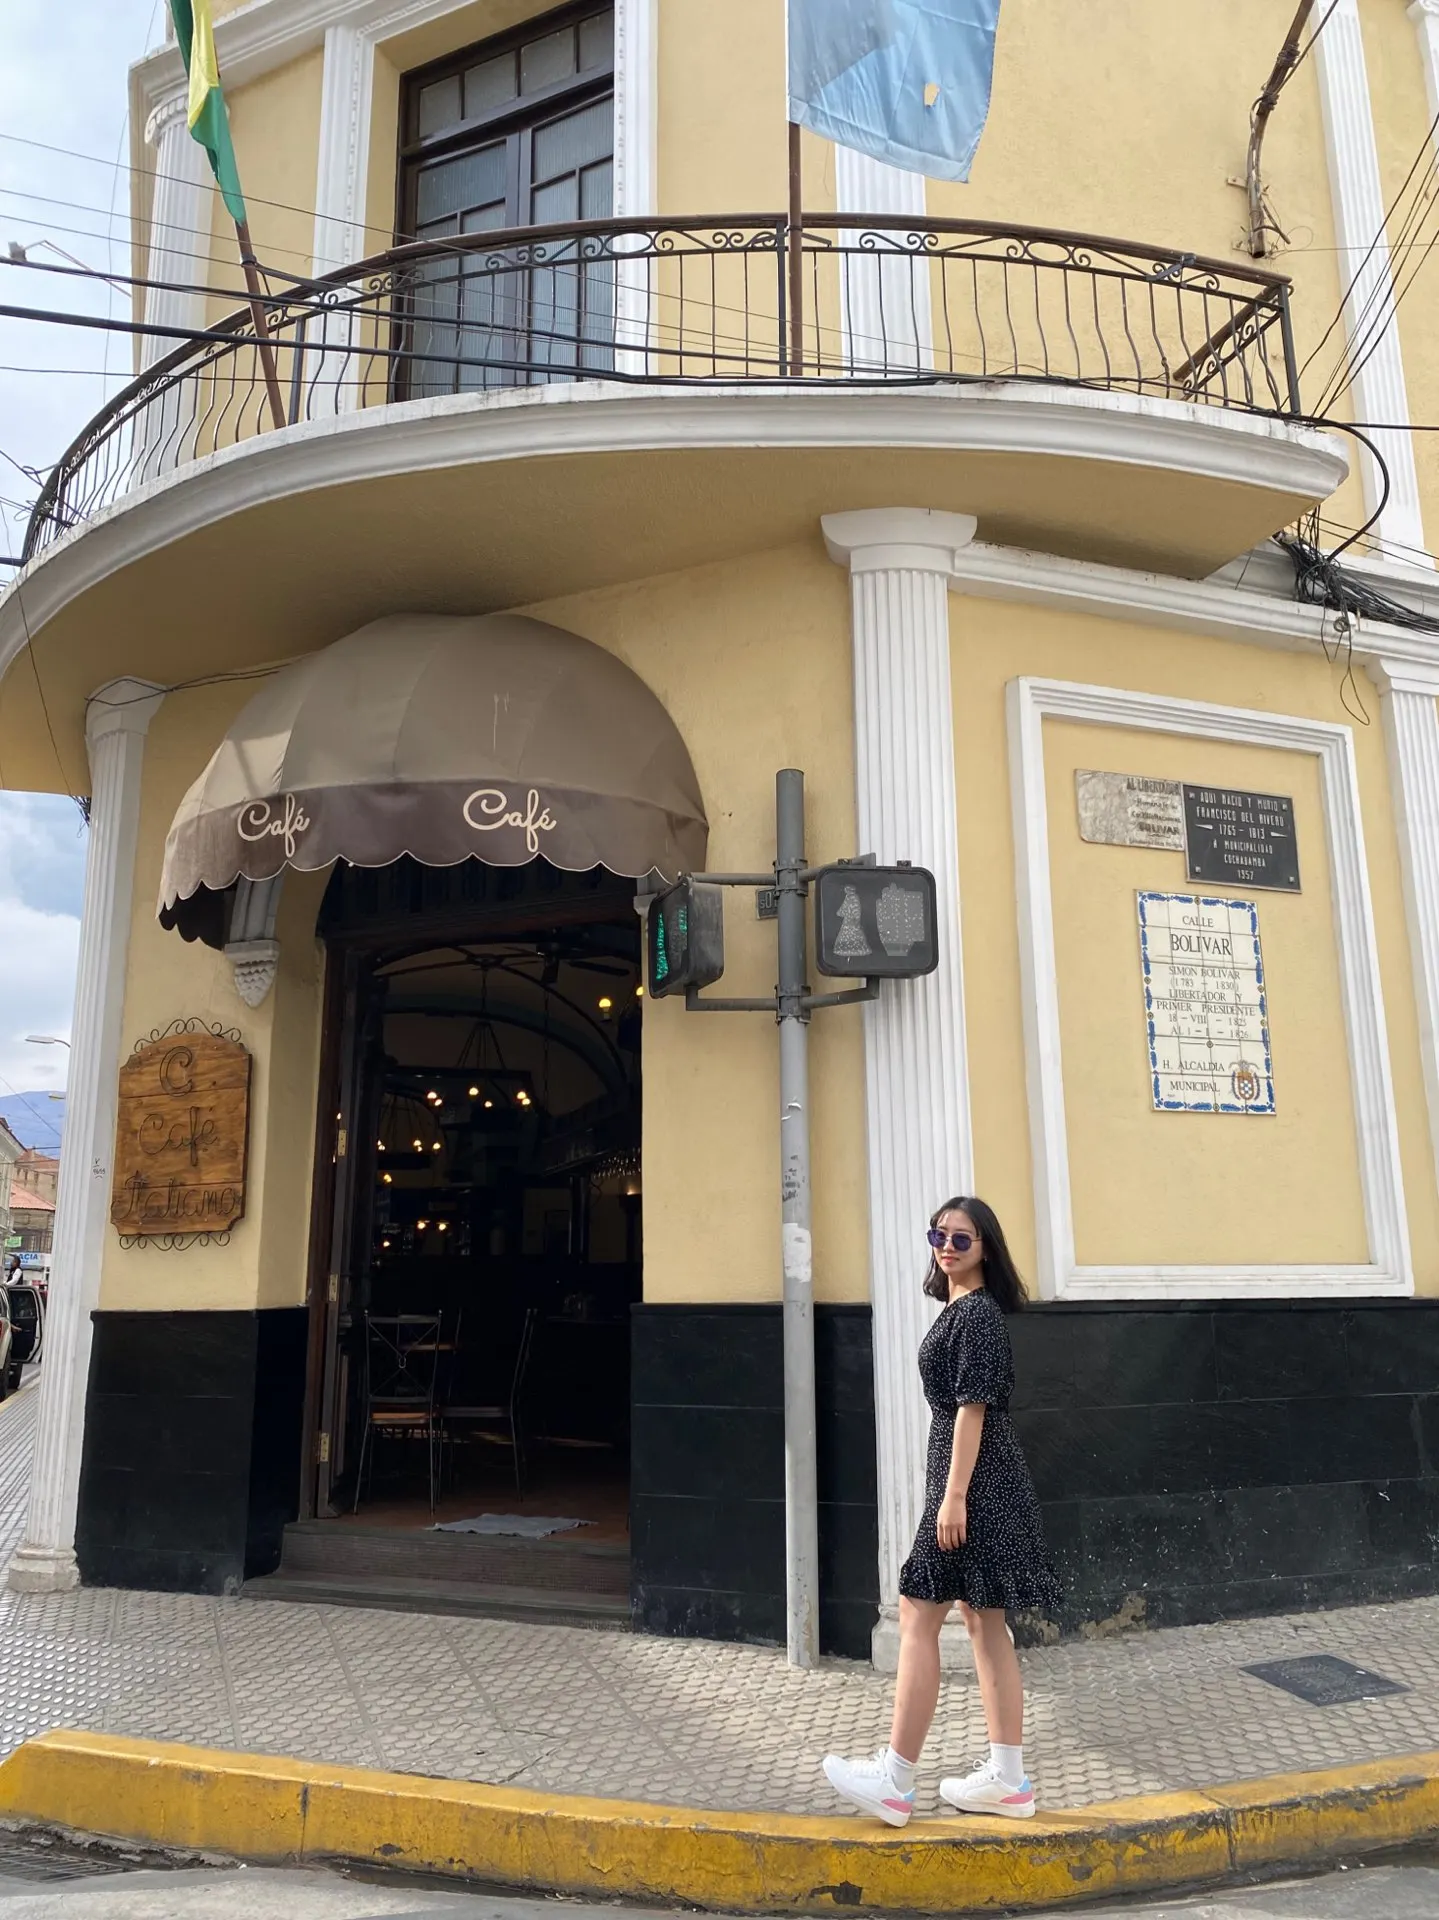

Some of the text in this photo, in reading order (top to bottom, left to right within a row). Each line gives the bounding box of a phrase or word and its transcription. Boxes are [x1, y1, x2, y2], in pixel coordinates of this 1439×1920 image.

[1200, 791, 1216, 804] AQUI
[1221, 793, 1242, 807] NACIO
[1257, 798, 1278, 812] MURIO
[238, 793, 309, 857] Café
[463, 789, 556, 852] Café
[1196, 806, 1236, 821] FRANCISCO
[1241, 811, 1254, 823] DEL
[1259, 813, 1284, 827] RIVERO
[1182, 915, 1214, 928] CALLE
[1171, 933, 1232, 956] BOLIVAR
[1169, 966, 1240, 980] SIMON BOLIVAR
[1169, 989, 1242, 1003] LIBERTADOR Y
[1156, 1000, 1256, 1017] PRIMER PRESIDENTE
[1178, 1060, 1225, 1072] ALCALDIA
[1170, 1081, 1220, 1093] MUNICIPAL
[139, 1106, 218, 1167] Café
